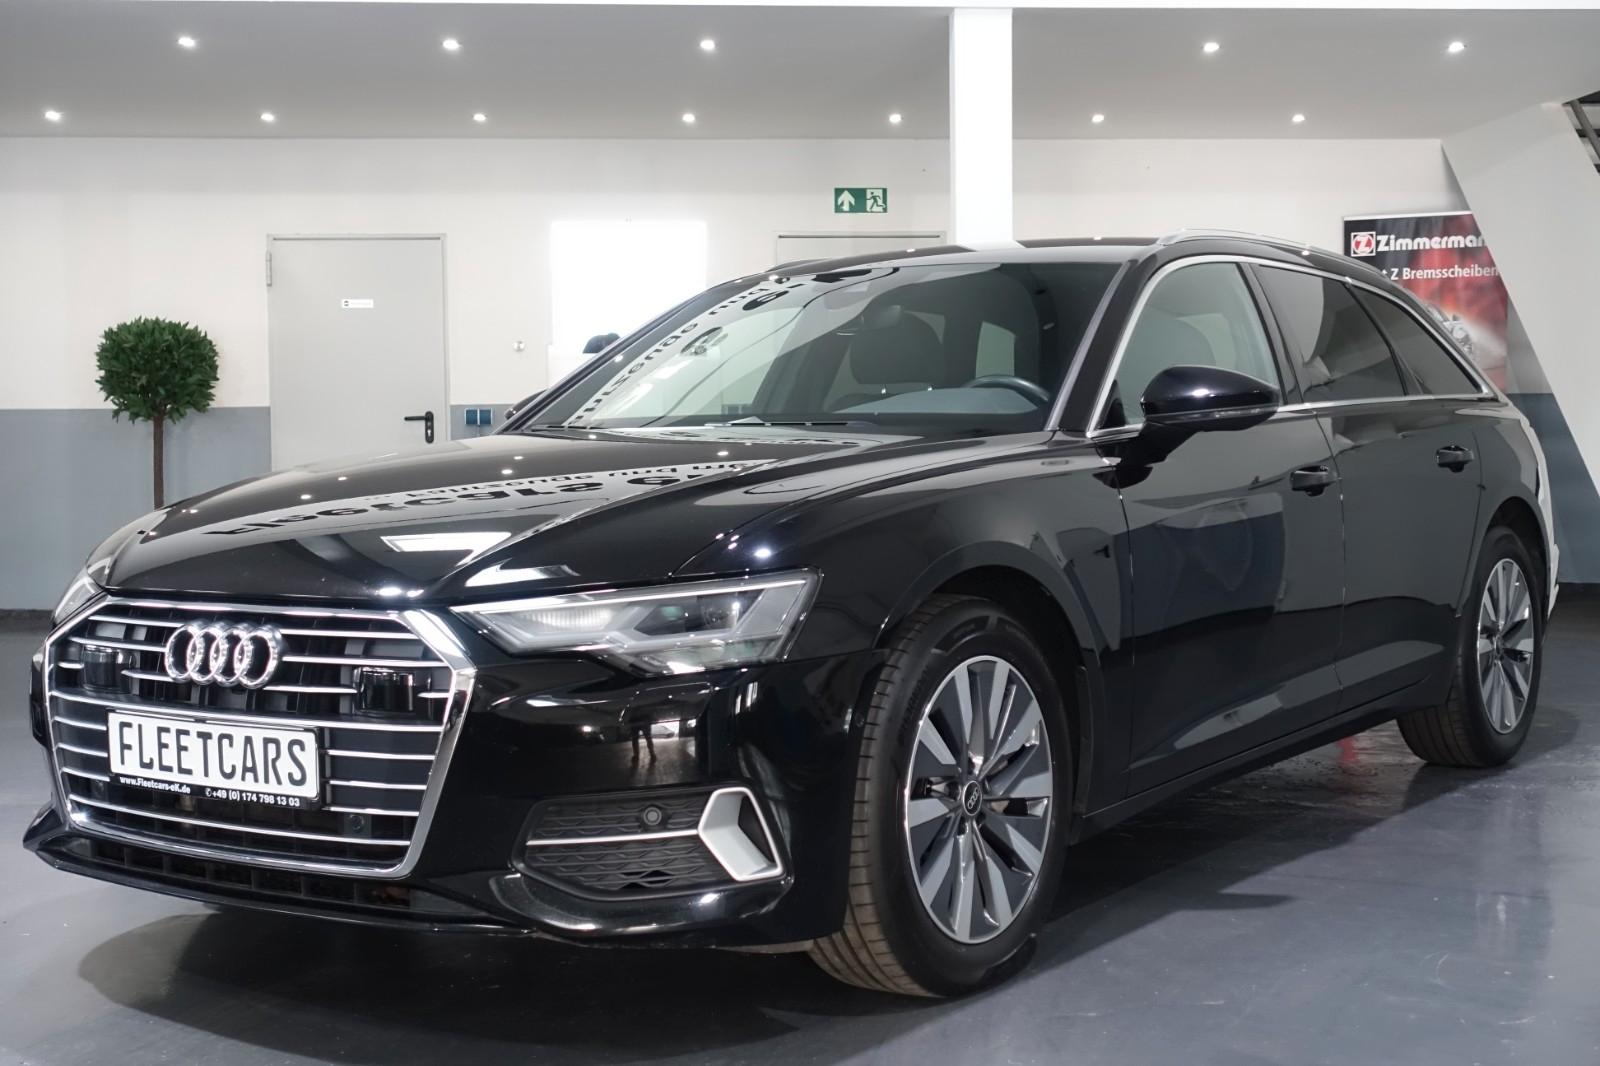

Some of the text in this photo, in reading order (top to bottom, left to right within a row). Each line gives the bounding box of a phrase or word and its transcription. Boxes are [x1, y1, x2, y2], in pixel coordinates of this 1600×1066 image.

[1391, 268, 1399, 280] Z
[1403, 264, 1499, 279] Bremsscheiben
[118, 721, 308, 786] FLEETCARS
[212, 789, 300, 807] +49 (0) 174 798 13 03
